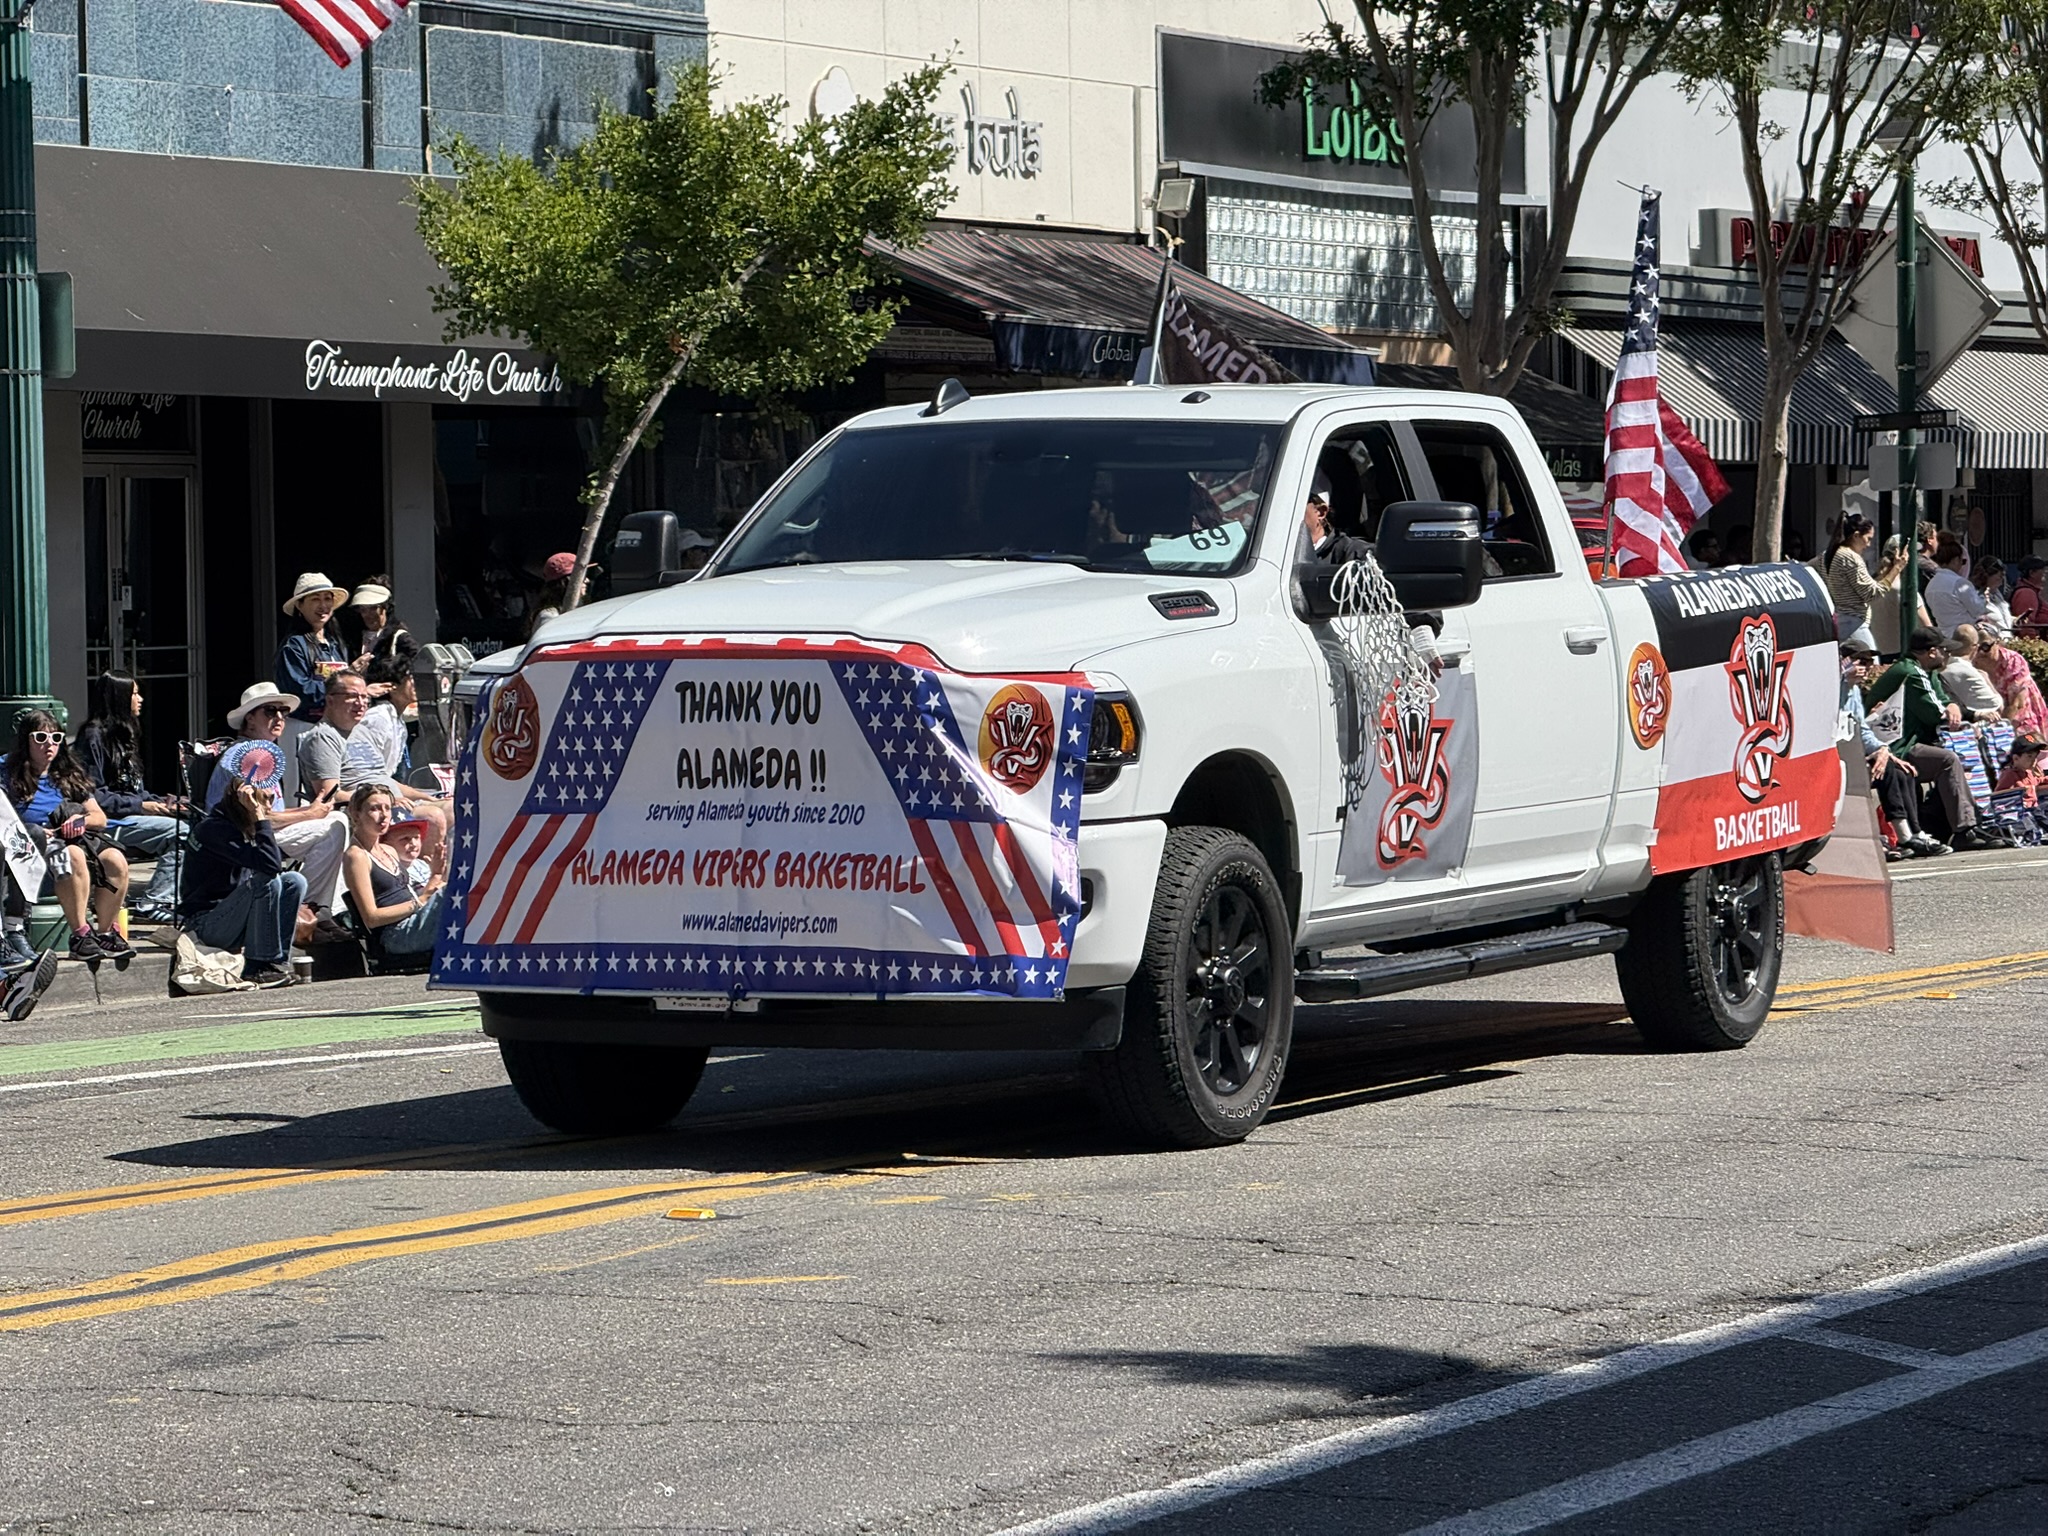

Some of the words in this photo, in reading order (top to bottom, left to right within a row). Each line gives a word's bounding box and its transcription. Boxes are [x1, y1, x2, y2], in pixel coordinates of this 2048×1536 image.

[305, 339, 439, 398] Triumphant
[440, 348, 484, 402] Life
[1093, 334, 1134, 363] Global
[83, 409, 142, 439] Church
[1188, 526, 1231, 551] 69
[1671, 576, 1761, 619] ALAMEDA
[1750, 569, 1806, 606] VIPERS
[462, 636, 503, 654] Sunday
[675, 680, 762, 724] THANK
[770, 679, 821, 725] YOU
[677, 746, 801, 791] ALAMEDA
[810, 749, 826, 792] !!
[646, 801, 694, 829] serving
[697, 798, 745, 822] Alameda
[746, 801, 790, 828] youth
[791, 803, 826, 825] since
[828, 803, 865, 826] 2010
[1714, 800, 1801, 851] BASKETBALL
[571, 848, 685, 886] ALAMEDA
[693, 847, 770, 889] VIPERS
[774, 851, 926, 894] BASKETBALL
